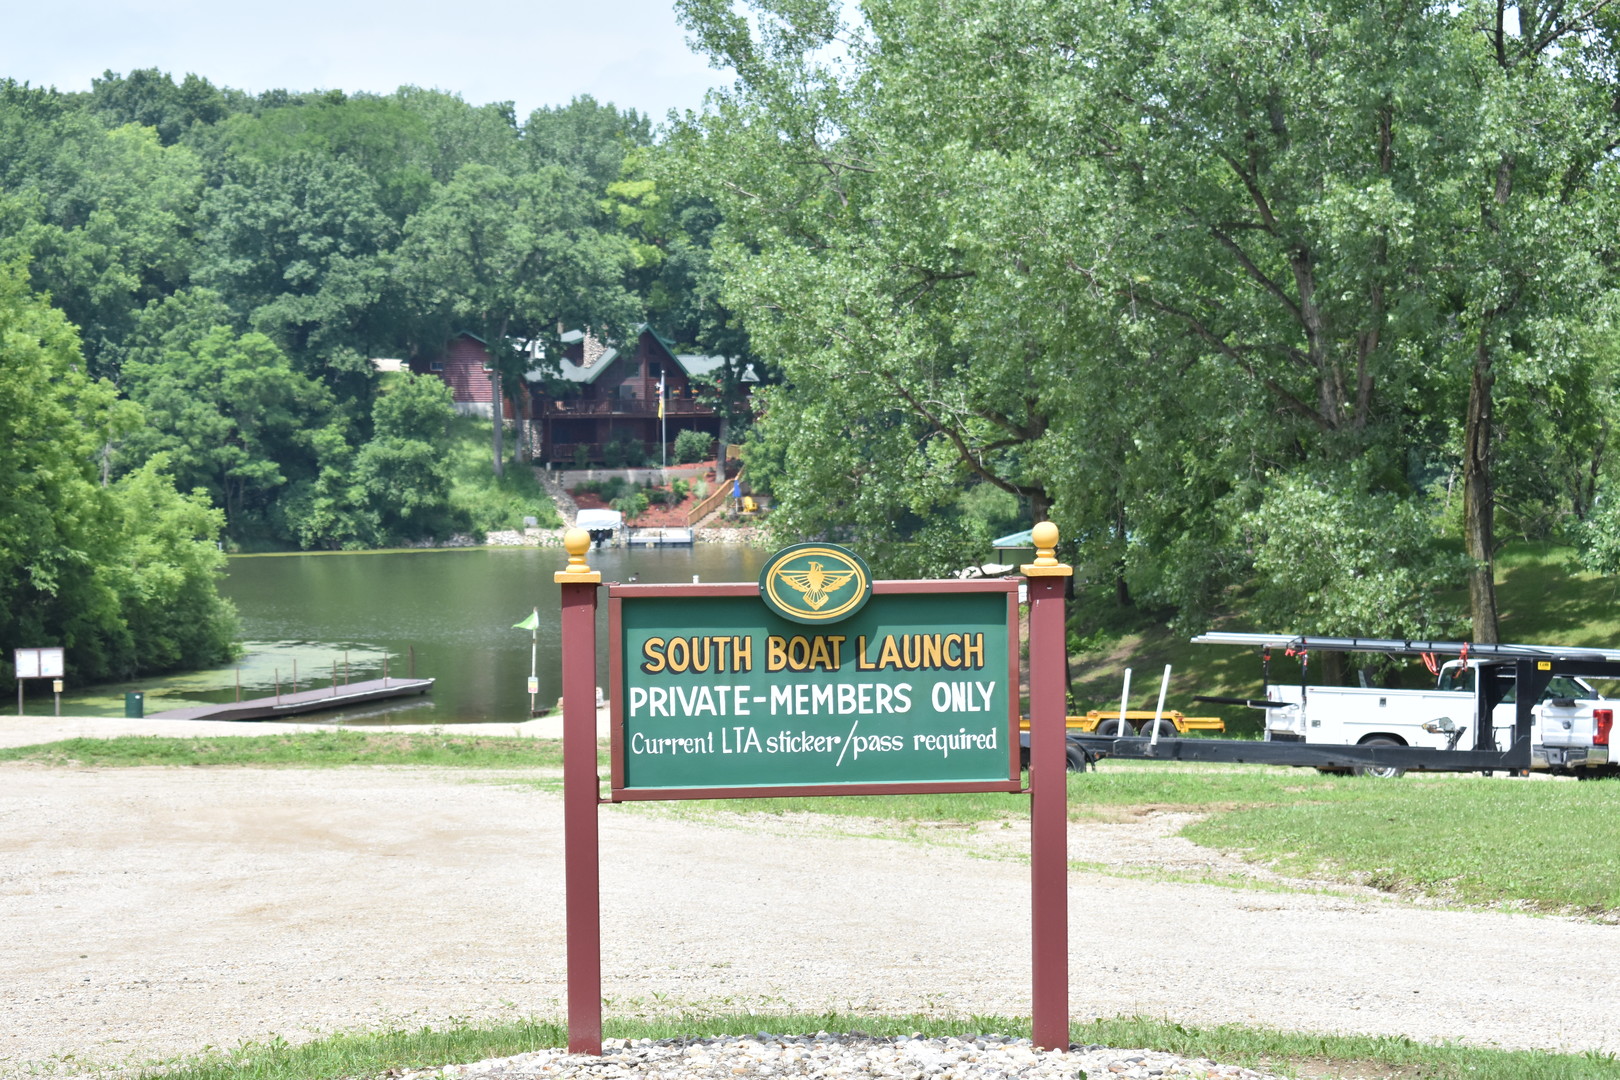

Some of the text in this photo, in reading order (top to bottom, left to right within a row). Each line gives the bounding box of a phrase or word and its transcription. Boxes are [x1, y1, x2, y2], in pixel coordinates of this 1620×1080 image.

[641, 632, 986, 674] SOUTH BOAT LAUNCH
[629, 681, 996, 717] PRIVATE-MEMBERS ONLY
[631, 720, 998, 767] Current LTA sticker/pass required
